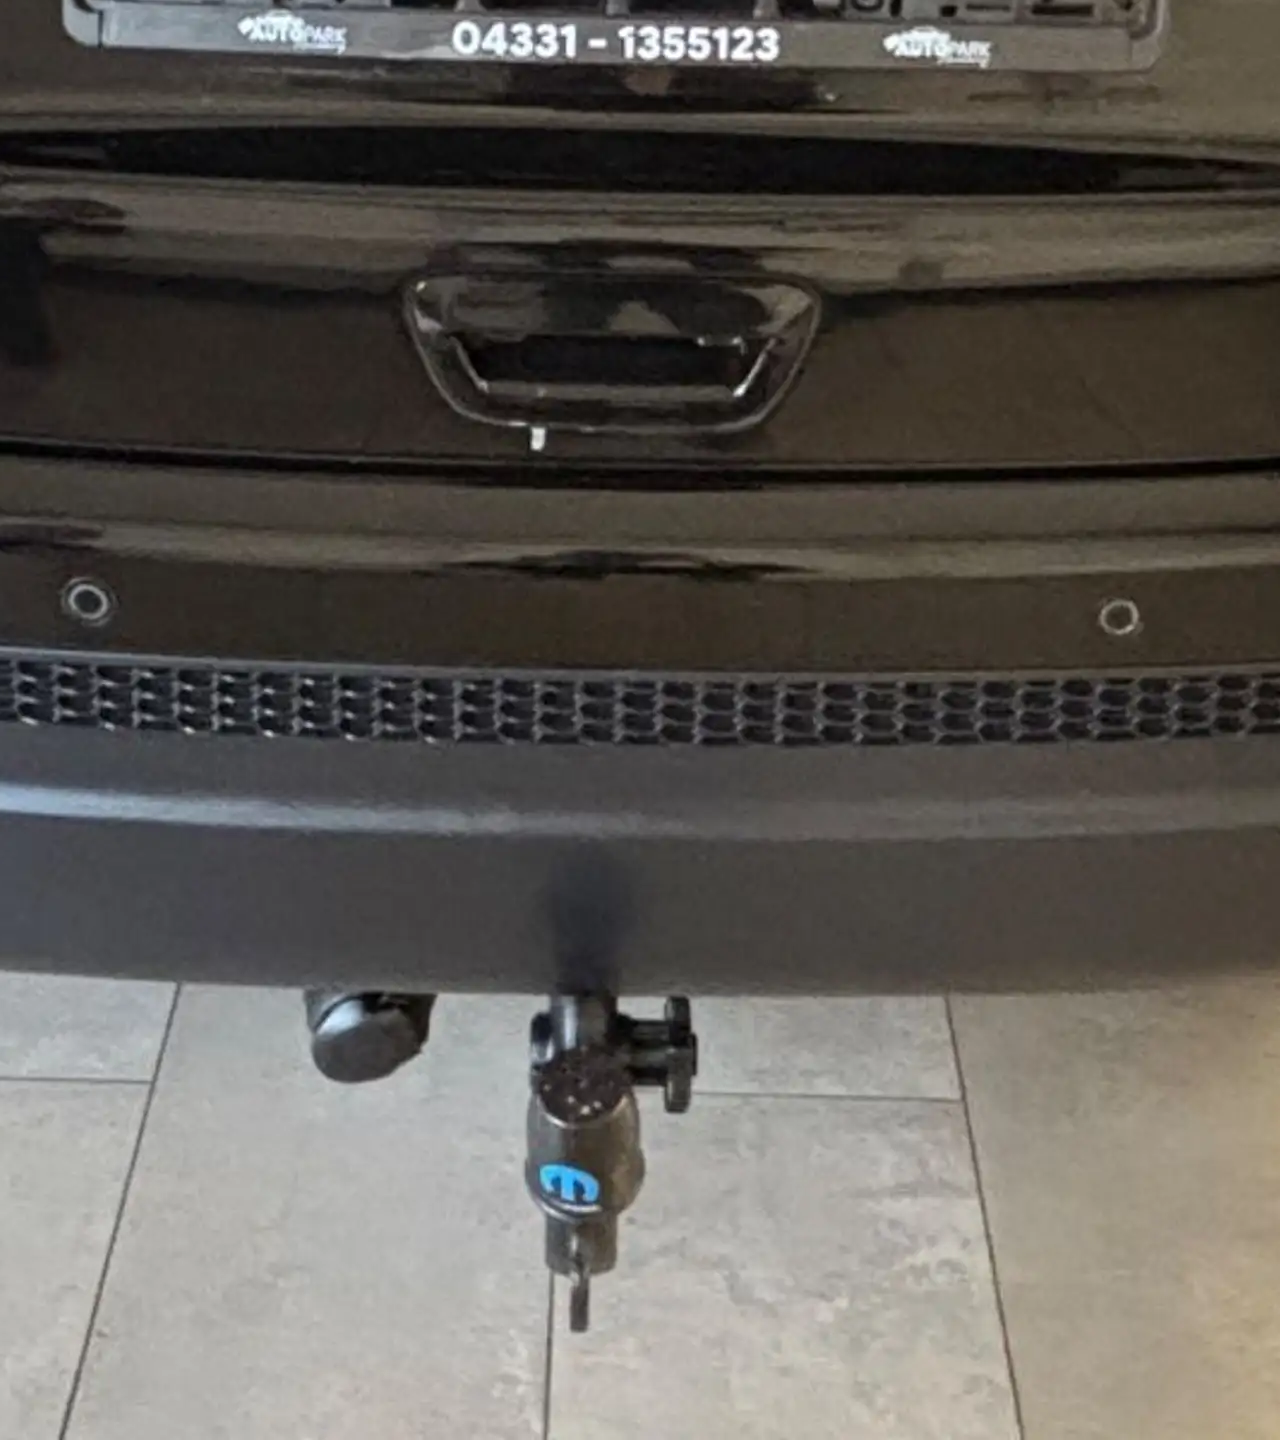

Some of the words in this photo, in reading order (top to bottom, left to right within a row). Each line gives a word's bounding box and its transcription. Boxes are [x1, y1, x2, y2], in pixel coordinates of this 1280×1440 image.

[451, 21, 577, 58] 04331
[587, 38, 608, 49] -
[618, 26, 781, 62] 1355123
